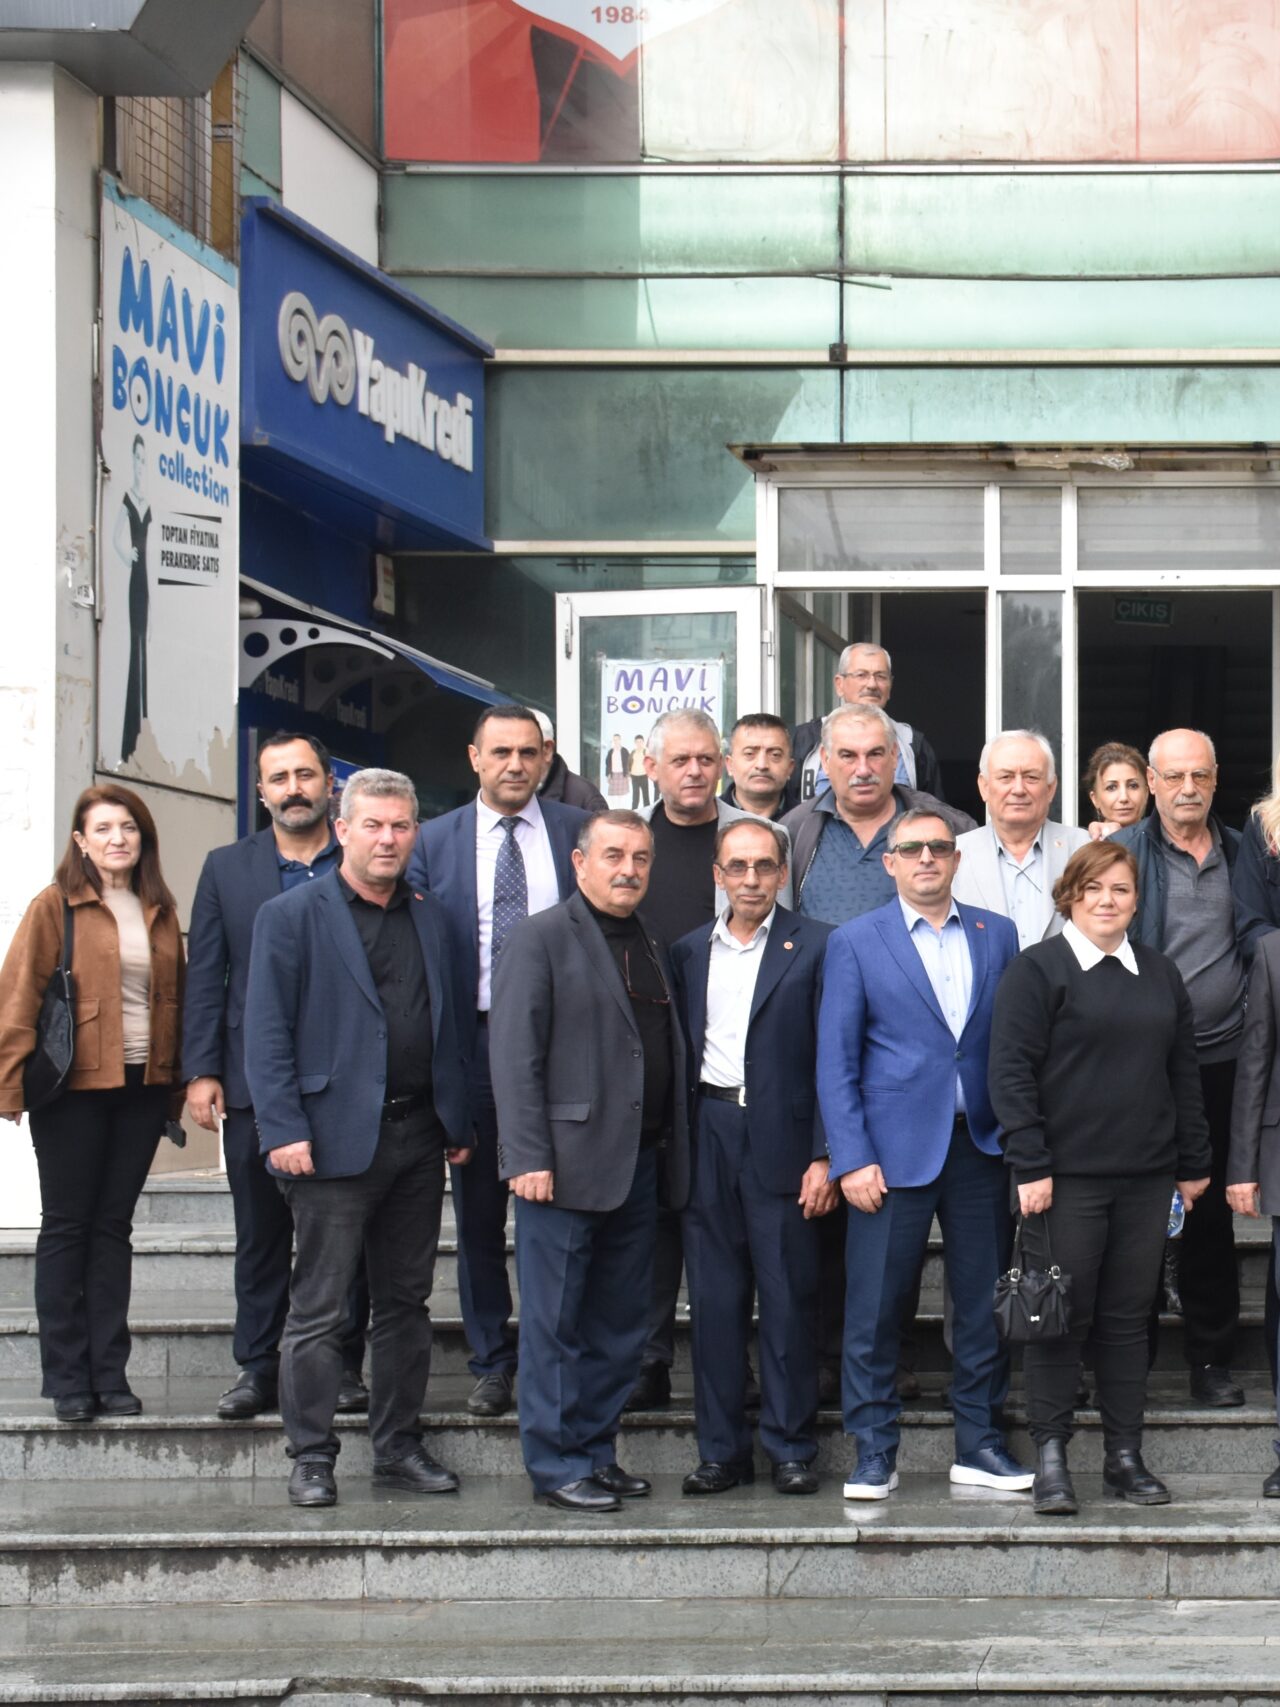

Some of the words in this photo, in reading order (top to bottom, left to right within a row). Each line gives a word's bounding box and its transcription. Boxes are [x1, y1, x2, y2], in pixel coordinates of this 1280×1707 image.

[591, 6, 647, 24] 1984
[112, 344, 229, 468] BONCUK
[159, 450, 229, 507] collection
[161, 524, 188, 545] TOPTAN
[190, 524, 219, 549] FİYATINA
[161, 550, 201, 571] PERAKENDE
[202, 556, 219, 578] SATIŞ
[607, 695, 716, 714] BONCUK
